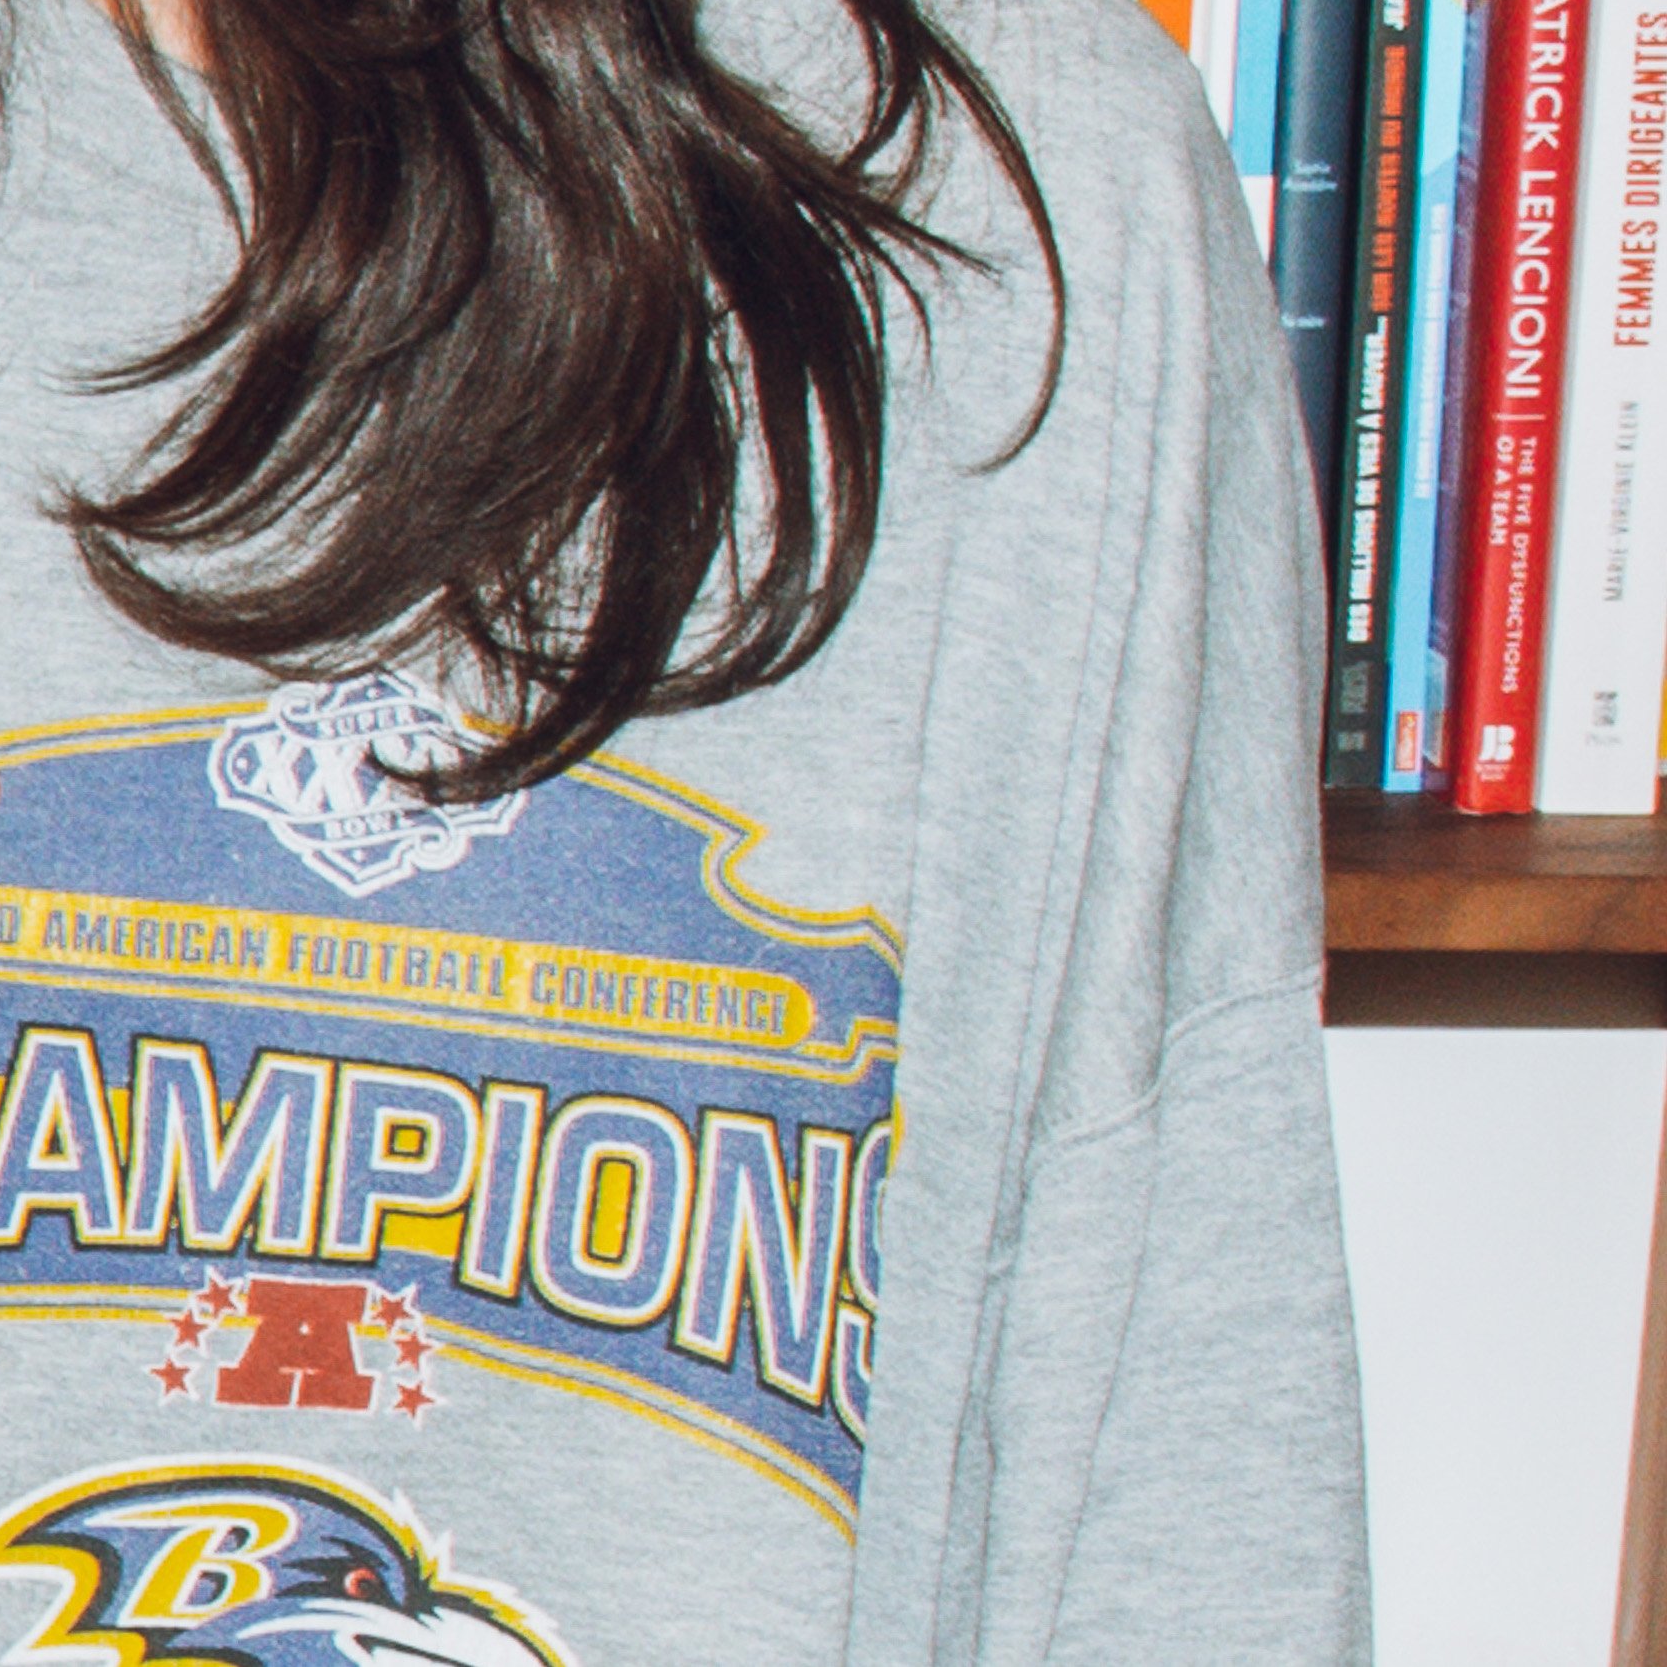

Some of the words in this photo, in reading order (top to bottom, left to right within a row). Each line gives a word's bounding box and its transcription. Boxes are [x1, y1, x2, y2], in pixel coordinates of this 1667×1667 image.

[1625, 11, 1667, 206] DIRIGEANTES
[1506, 171, 1556, 398] LENCIONI
[1614, 220, 1658, 348] FEMMES
[1495, 436, 1512, 464] OF
[1518, 436, 1537, 476] THE
[1493, 468, 1509, 485] A
[1489, 490, 1508, 546] TEAM
[1515, 483, 1534, 524] FIVE
[1499, 533, 1530, 693] DYSFUNCTIONS
[316, 705, 415, 738] SUPER
[325, 809, 415, 840] BOWL
[43, 907, 268, 979] AMERICAN
[287, 927, 510, 1000] FOOTBALL
[527, 958, 795, 1042] CONFERENCE
